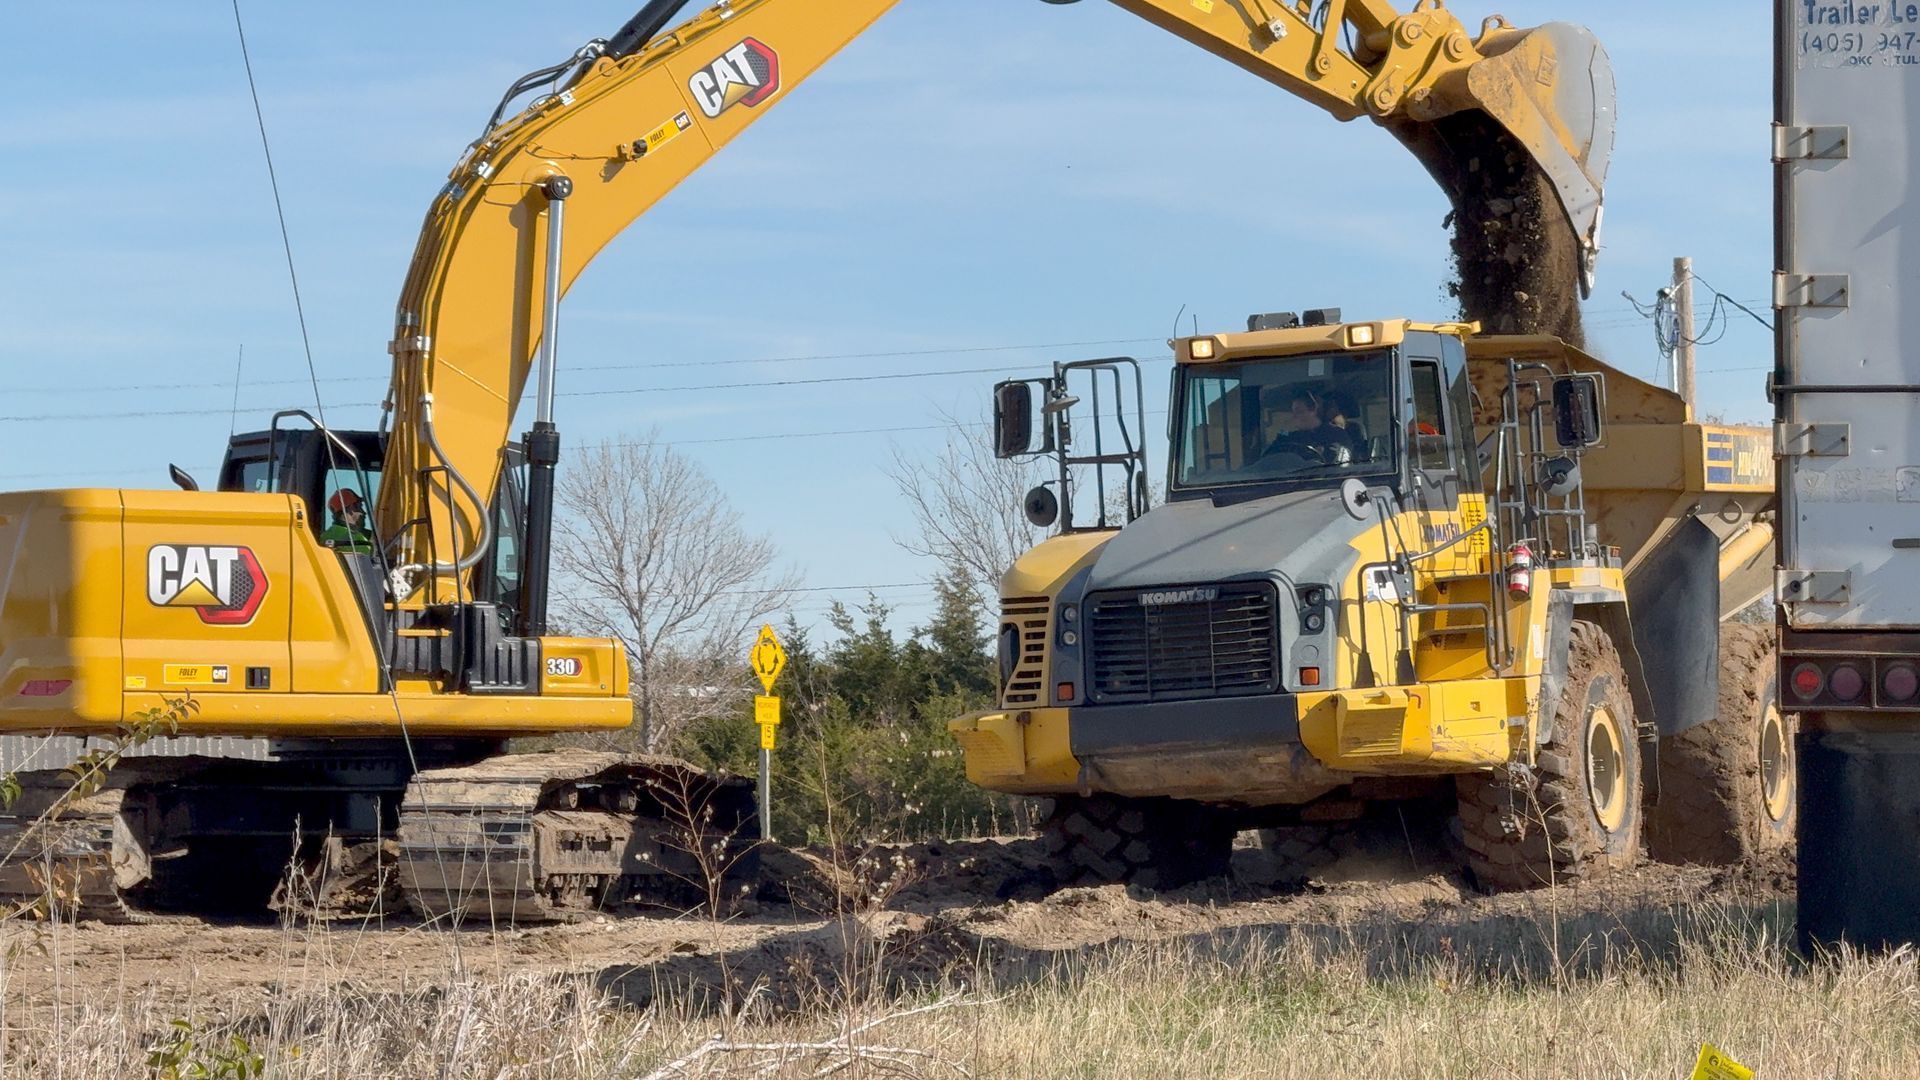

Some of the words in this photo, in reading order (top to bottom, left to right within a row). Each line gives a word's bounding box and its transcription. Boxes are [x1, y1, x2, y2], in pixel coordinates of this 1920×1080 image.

[1804, 0, 1880, 24] Trailer
[1802, 32, 1863, 53] (405)
[1877, 32, 1920, 52] 947-
[1894, 55, 1920, 65] TUL
[689, 42, 761, 118] CAT
[675, 114, 689, 129] CAT
[1423, 523, 1461, 543] KOMATSU
[149, 545, 239, 606] CAT
[1141, 588, 1216, 605] KOMATSU
[178, 668, 198, 676] FOLEY
[213, 669, 227, 680] CAT
[546, 658, 575, 675] 330
